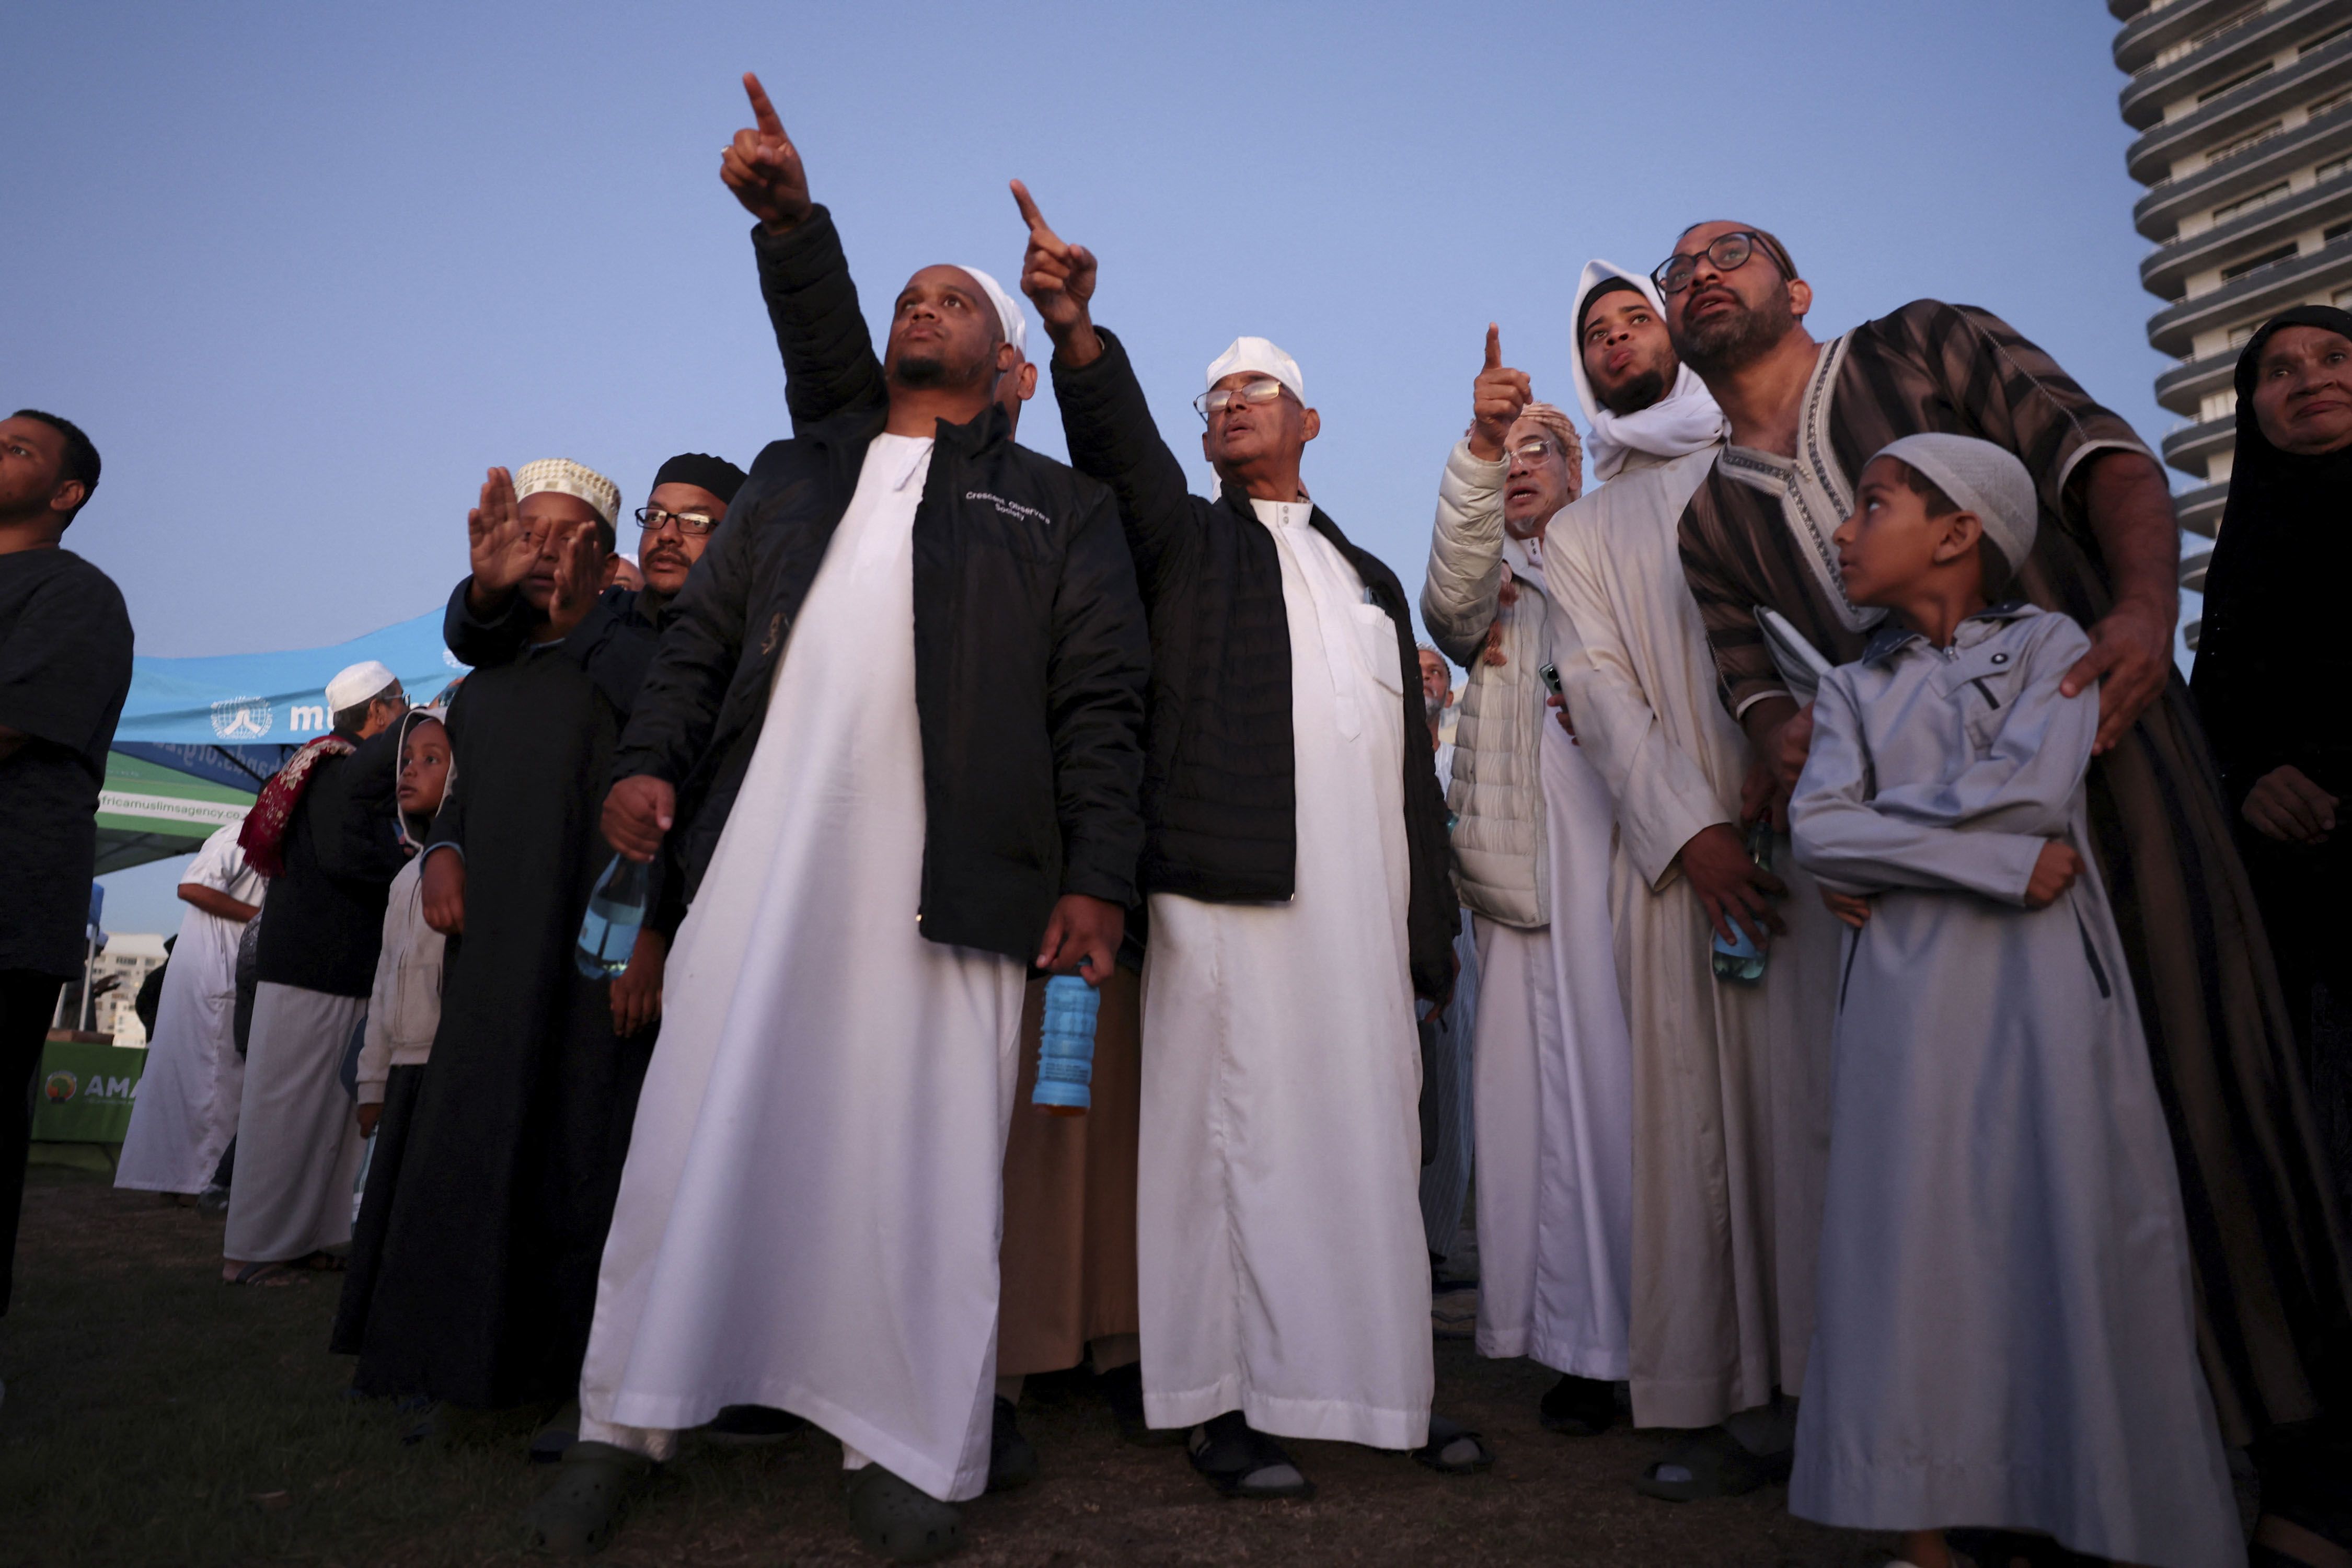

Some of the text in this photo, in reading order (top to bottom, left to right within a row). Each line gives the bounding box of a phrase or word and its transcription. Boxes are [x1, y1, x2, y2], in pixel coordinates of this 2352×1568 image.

[965, 491, 1051, 525] Crescent Observers
[995, 502, 1024, 521] Society
